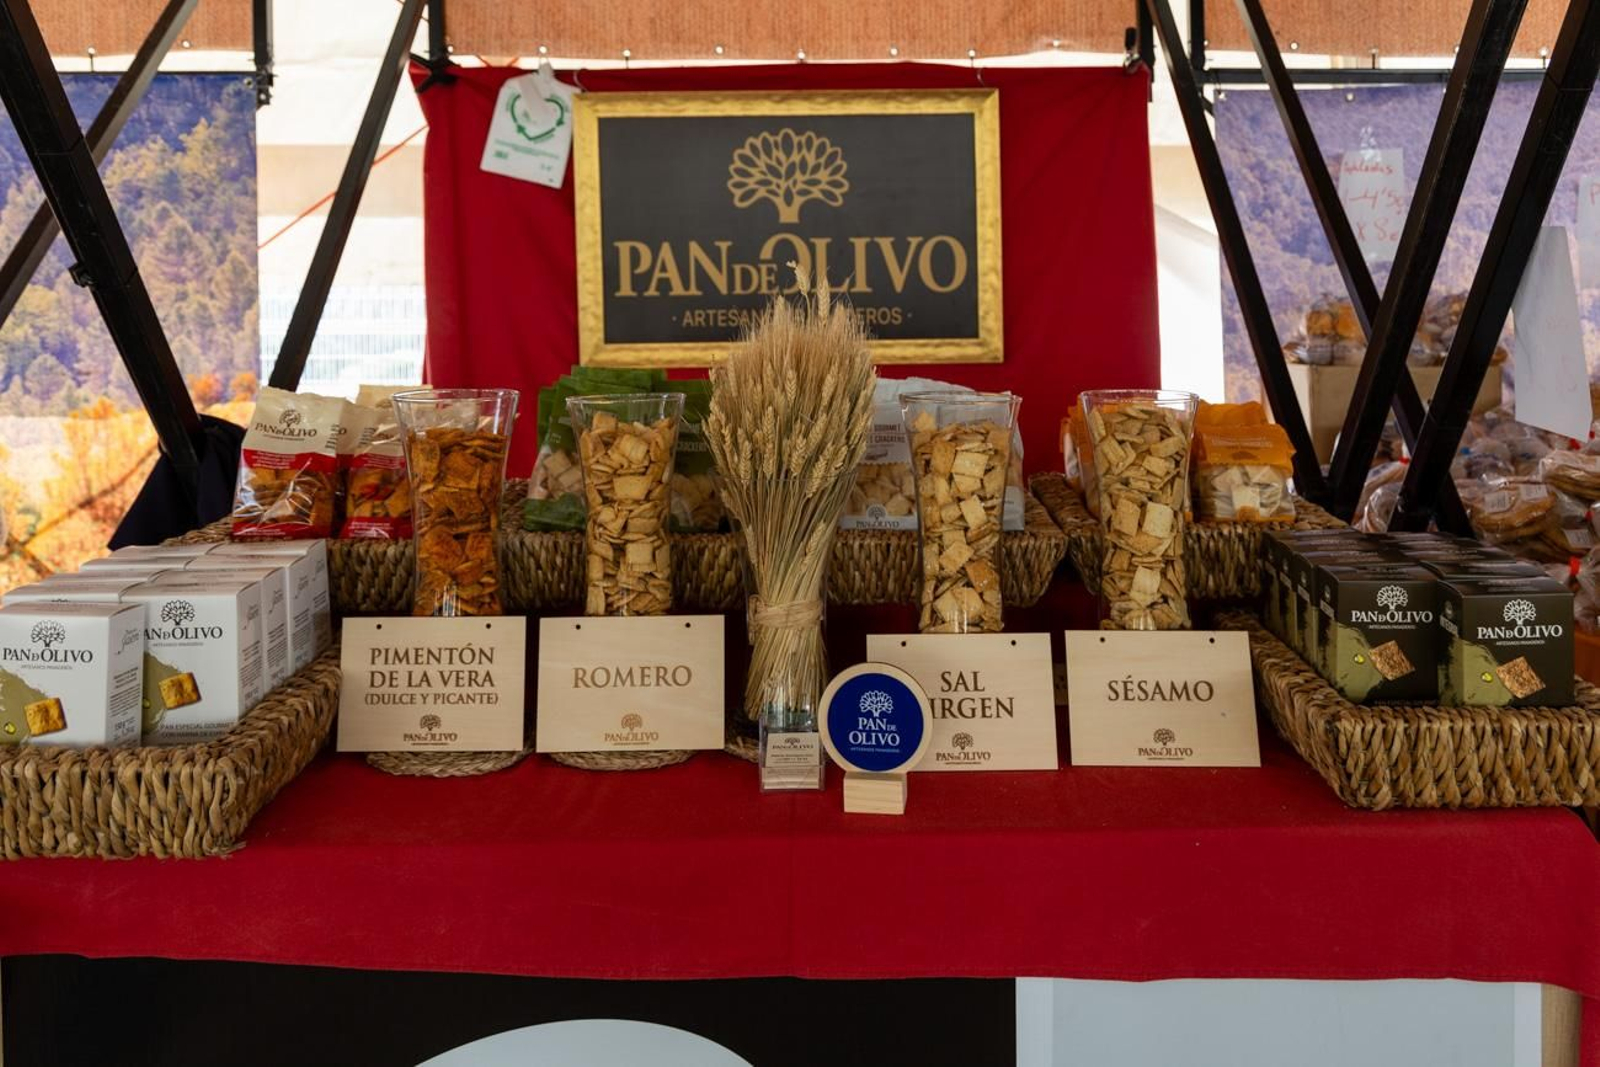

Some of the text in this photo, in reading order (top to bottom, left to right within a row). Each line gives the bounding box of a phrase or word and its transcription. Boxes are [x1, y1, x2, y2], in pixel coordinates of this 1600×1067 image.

[613, 232, 968, 296] PAN DE OLIVO
[1351, 610, 1378, 623] PAN
[1387, 609, 1433, 623] OLIVO
[143, 627, 162, 640] AN
[171, 626, 223, 640] OLIVO
[1477, 627, 1505, 640] PAN
[1514, 624, 1562, 638] OLIVO
[3, 648, 31, 661] PAN
[40, 648, 94, 663] OLIVO
[370, 643, 495, 665] PIMENTÓN
[369, 670, 495, 688] DE LA VERA
[572, 665, 693, 689] ROMERO
[940, 671, 985, 693] SAL
[1107, 675, 1214, 702] SÉSAMO
[365, 692, 498, 705] (DULCE Y PICANTE)
[930, 697, 1015, 720] IRGEN
[858, 717, 887, 731] PAN
[403, 733, 421, 742] PAN
[604, 733, 622, 742] PAN
[849, 730, 900, 746] OLIVO
[936, 752, 954, 761] PAN
[1138, 748, 1156, 756] PAN
